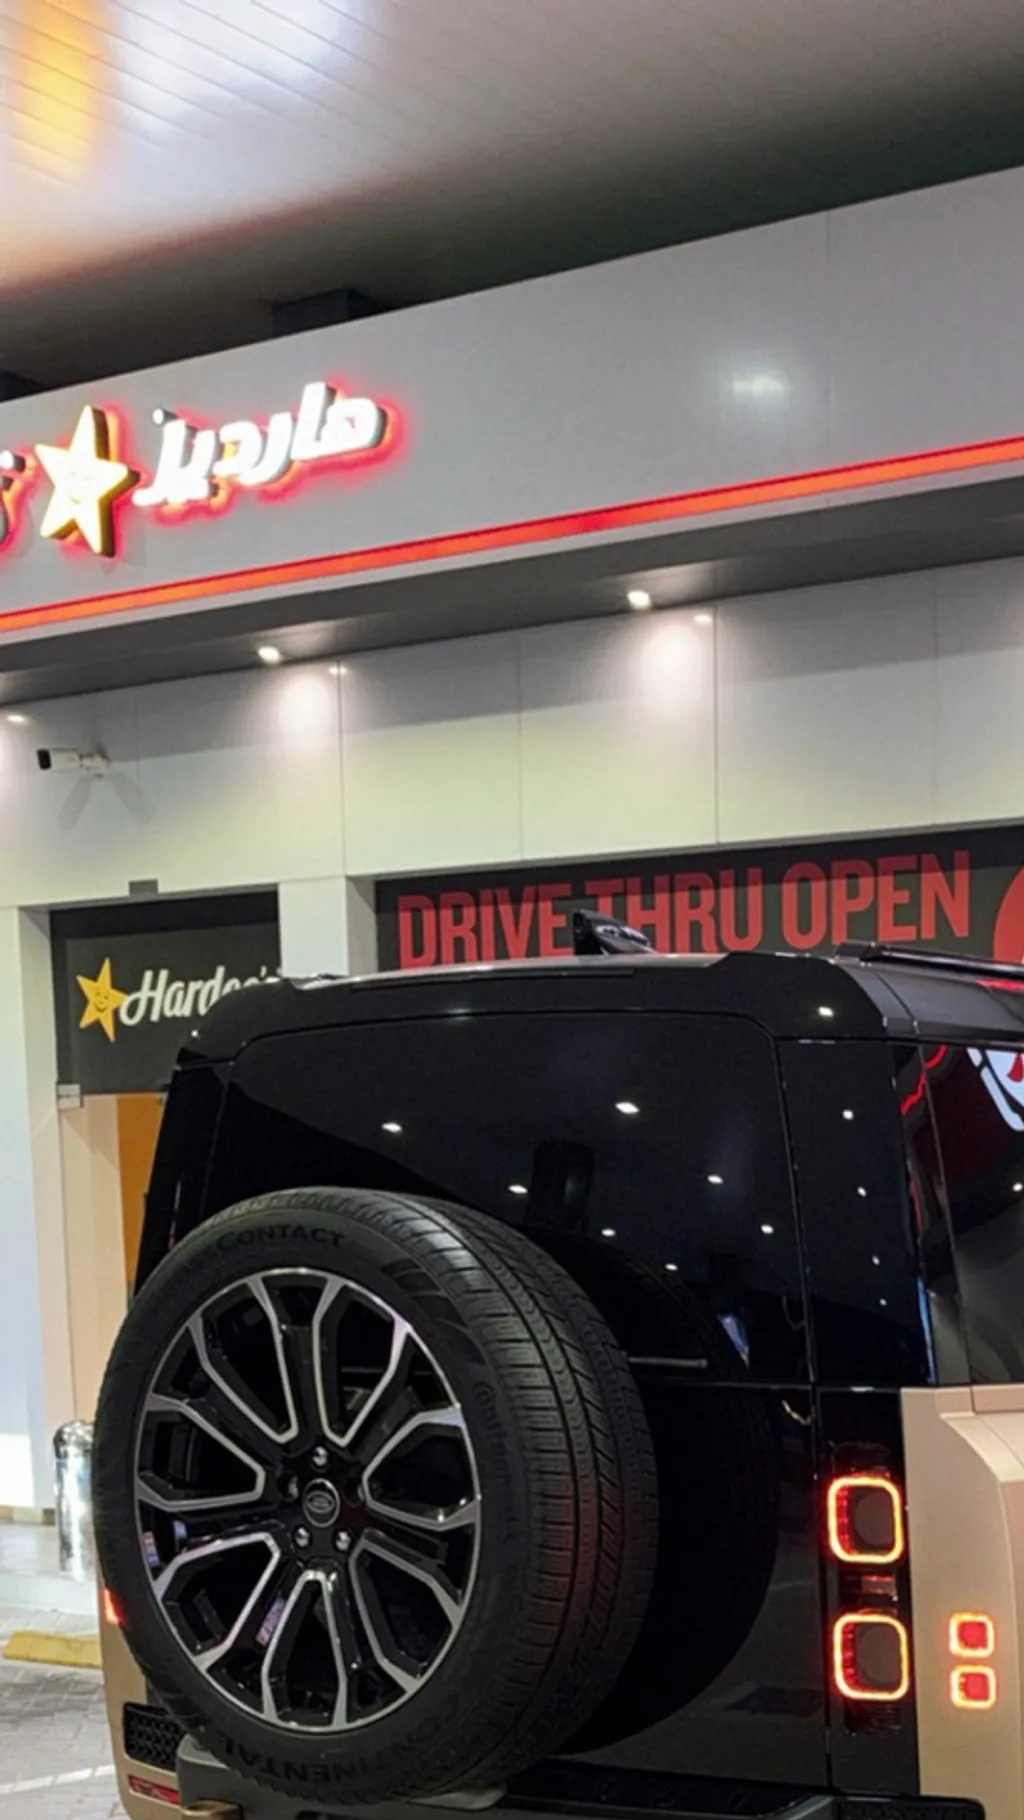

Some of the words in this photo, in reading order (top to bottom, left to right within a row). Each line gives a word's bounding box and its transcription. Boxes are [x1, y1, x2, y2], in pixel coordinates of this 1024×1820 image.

[132, 381, 380, 506] هارديز
[399, 883, 572, 971] DRIVE
[586, 868, 763, 954] THRU
[781, 850, 971, 946] OPEN
[119, 965, 282, 1026] Hard'
[214, 1222, 347, 1252] CONTACT
